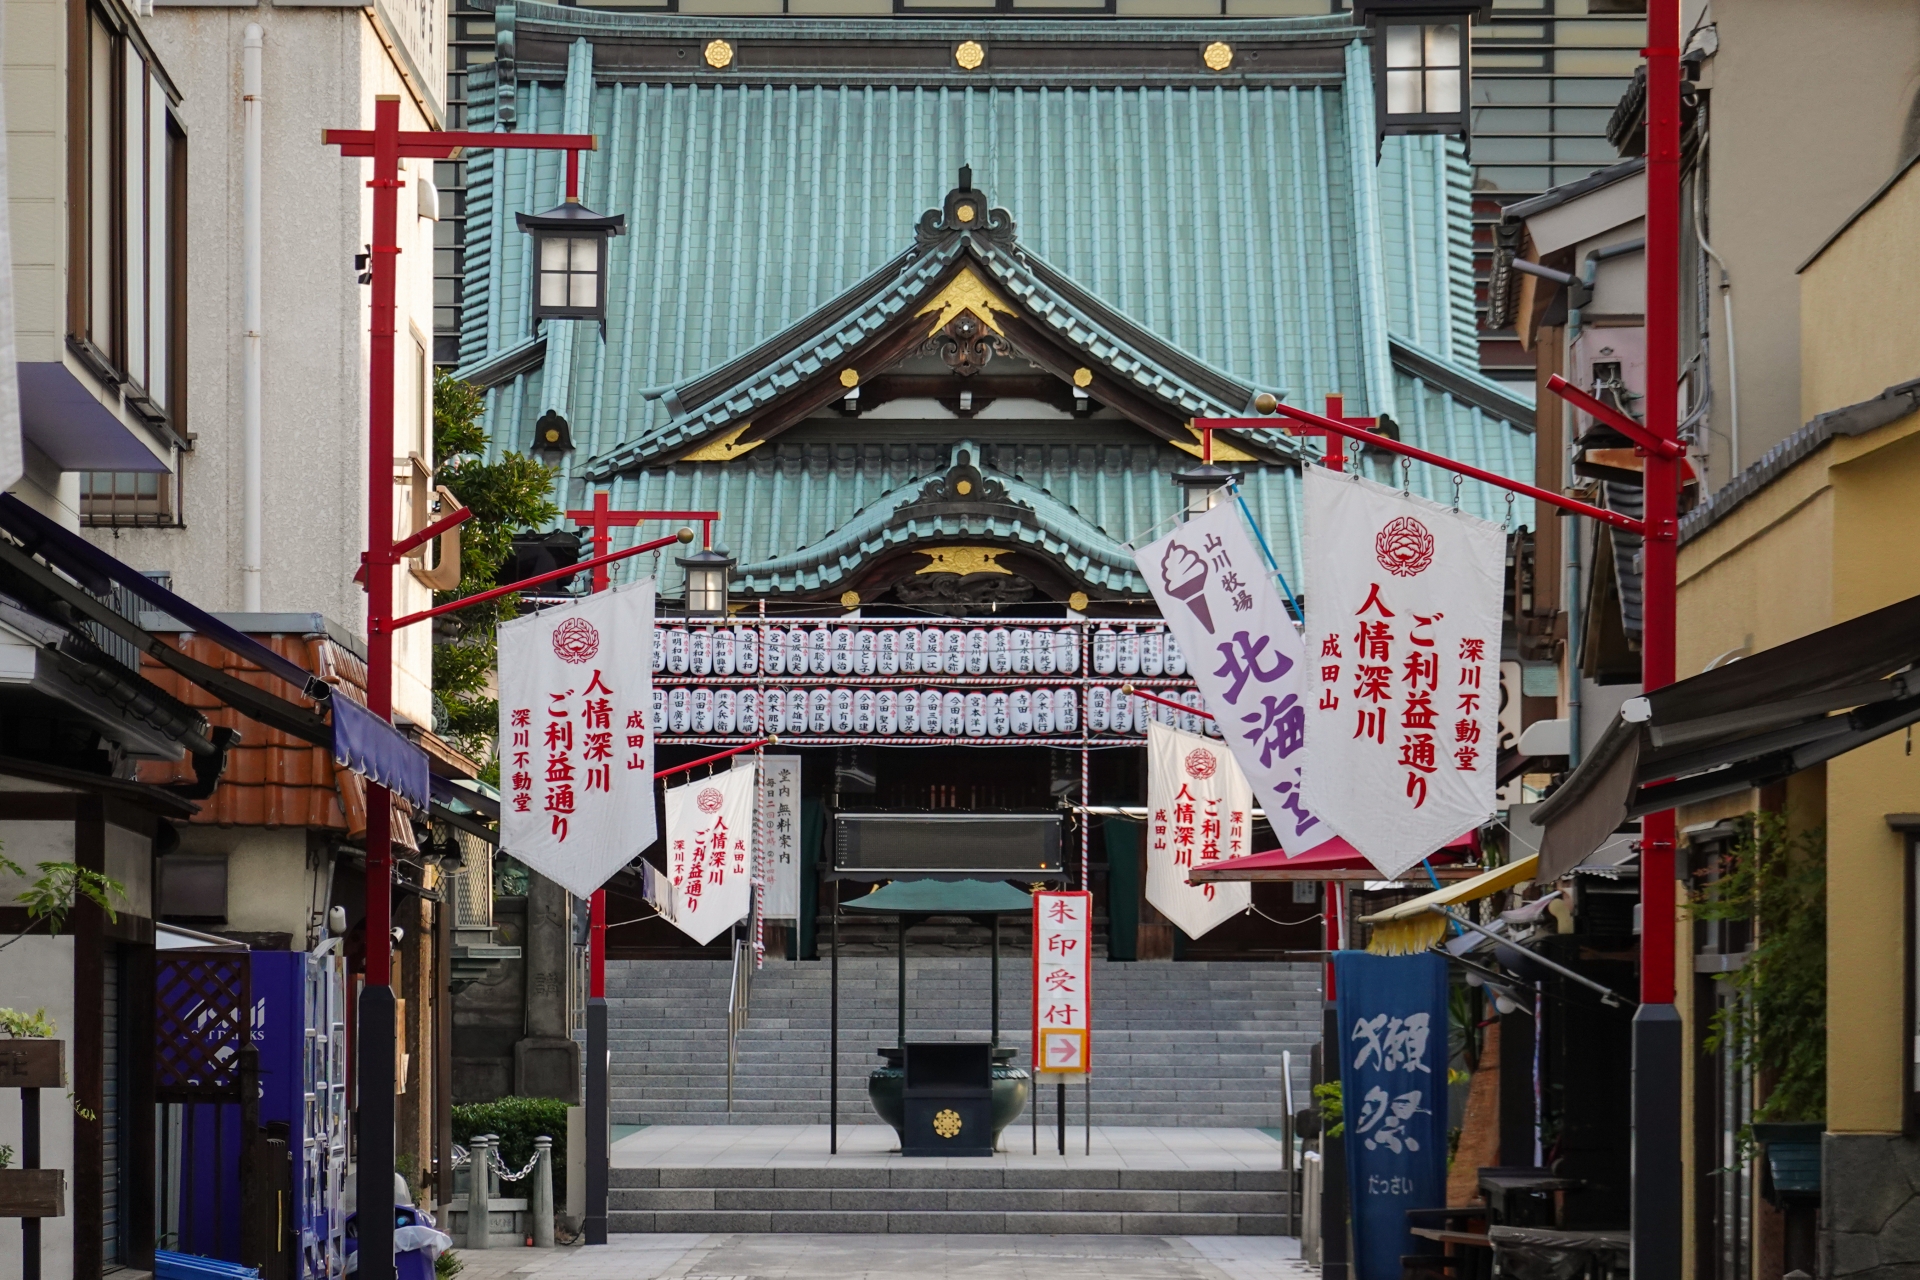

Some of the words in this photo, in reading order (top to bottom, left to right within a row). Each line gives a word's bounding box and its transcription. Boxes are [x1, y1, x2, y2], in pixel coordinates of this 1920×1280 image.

[1203, 533, 1253, 612] 山川牧場
[1319, 633, 1342, 710] 成田山
[1353, 582, 1395, 745] 人情深川
[1454, 638, 1485, 771] 深川不動堂
[582, 669, 614, 792] 人情深川
[627, 710, 645, 770] 成田山
[1398, 612, 1444, 809] ご利益通り
[512, 708, 532, 812] 深川不動堂
[545, 689, 575, 842] ご利益通り
[707, 815, 728, 885] 人情深川
[733, 840, 745, 874] 成田山
[1154, 808, 1168, 850] 成田山
[1173, 783, 1196, 869] 人情深川
[683, 828, 709, 912] ご利益通り
[1045, 900, 1077, 1025] 朱印受付
[1352, 1012, 1432, 1154] 獺祭
[1368, 1174, 1413, 1194] だっさい
